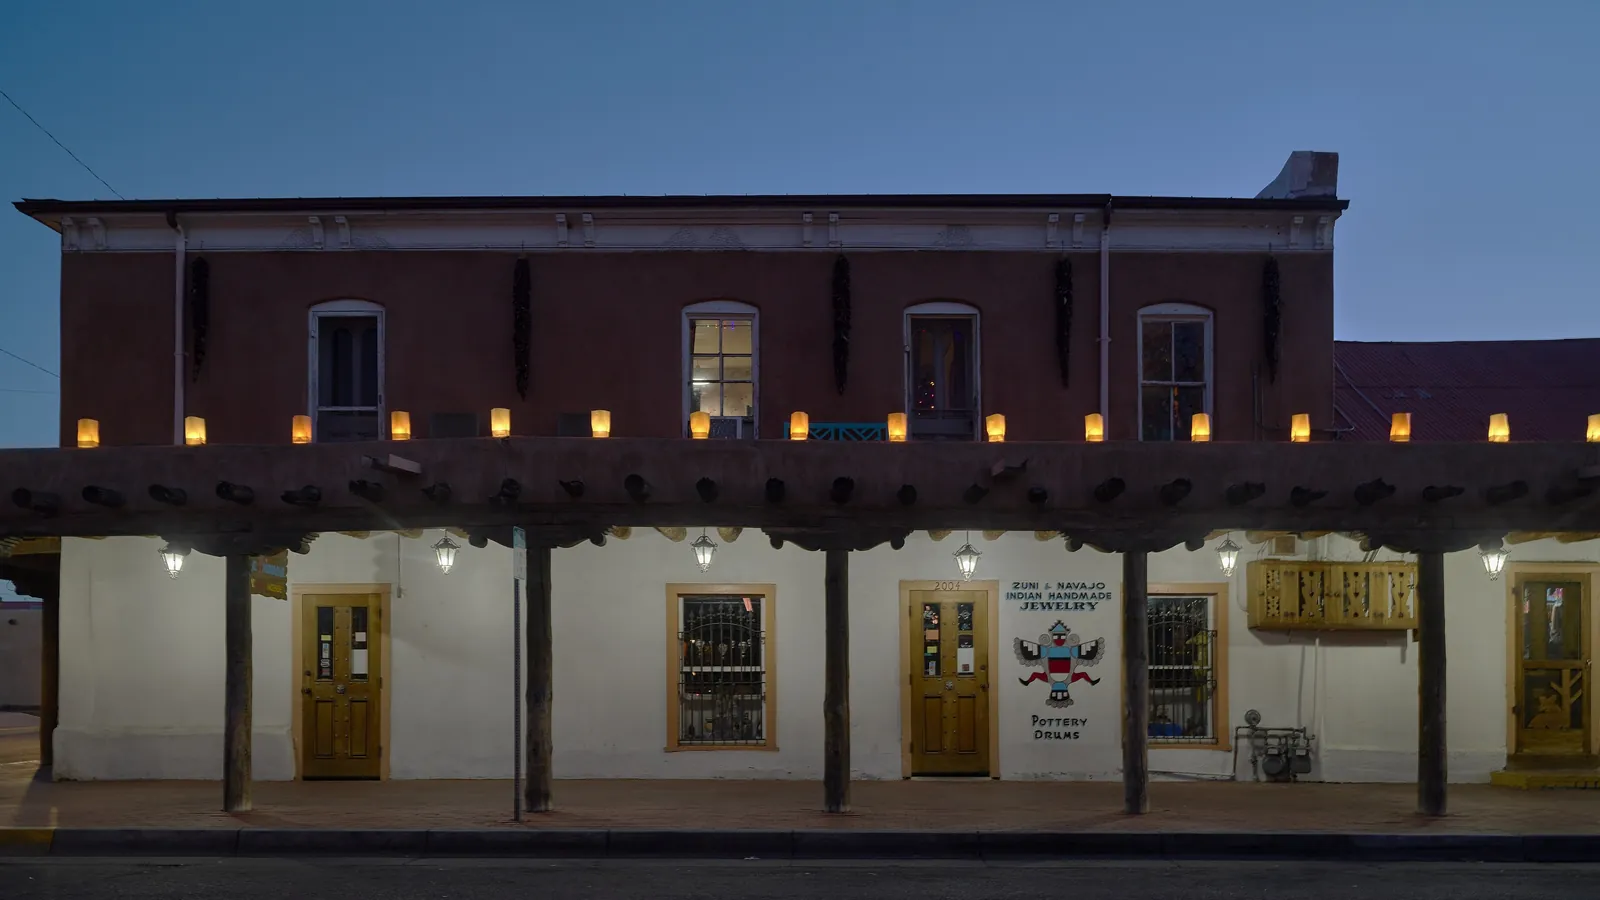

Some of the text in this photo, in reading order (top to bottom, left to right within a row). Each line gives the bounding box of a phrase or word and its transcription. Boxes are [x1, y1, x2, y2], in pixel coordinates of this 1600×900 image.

[935, 581, 960, 591] 2004
[1012, 582, 1039, 590] ZUNI
[1057, 582, 1106, 590] NAVAJO
[1006, 592, 1112, 600] INDIAN HANDMADE
[1020, 601, 1099, 611] JEWELRY
[1034, 729, 1080, 740] DRUMS
